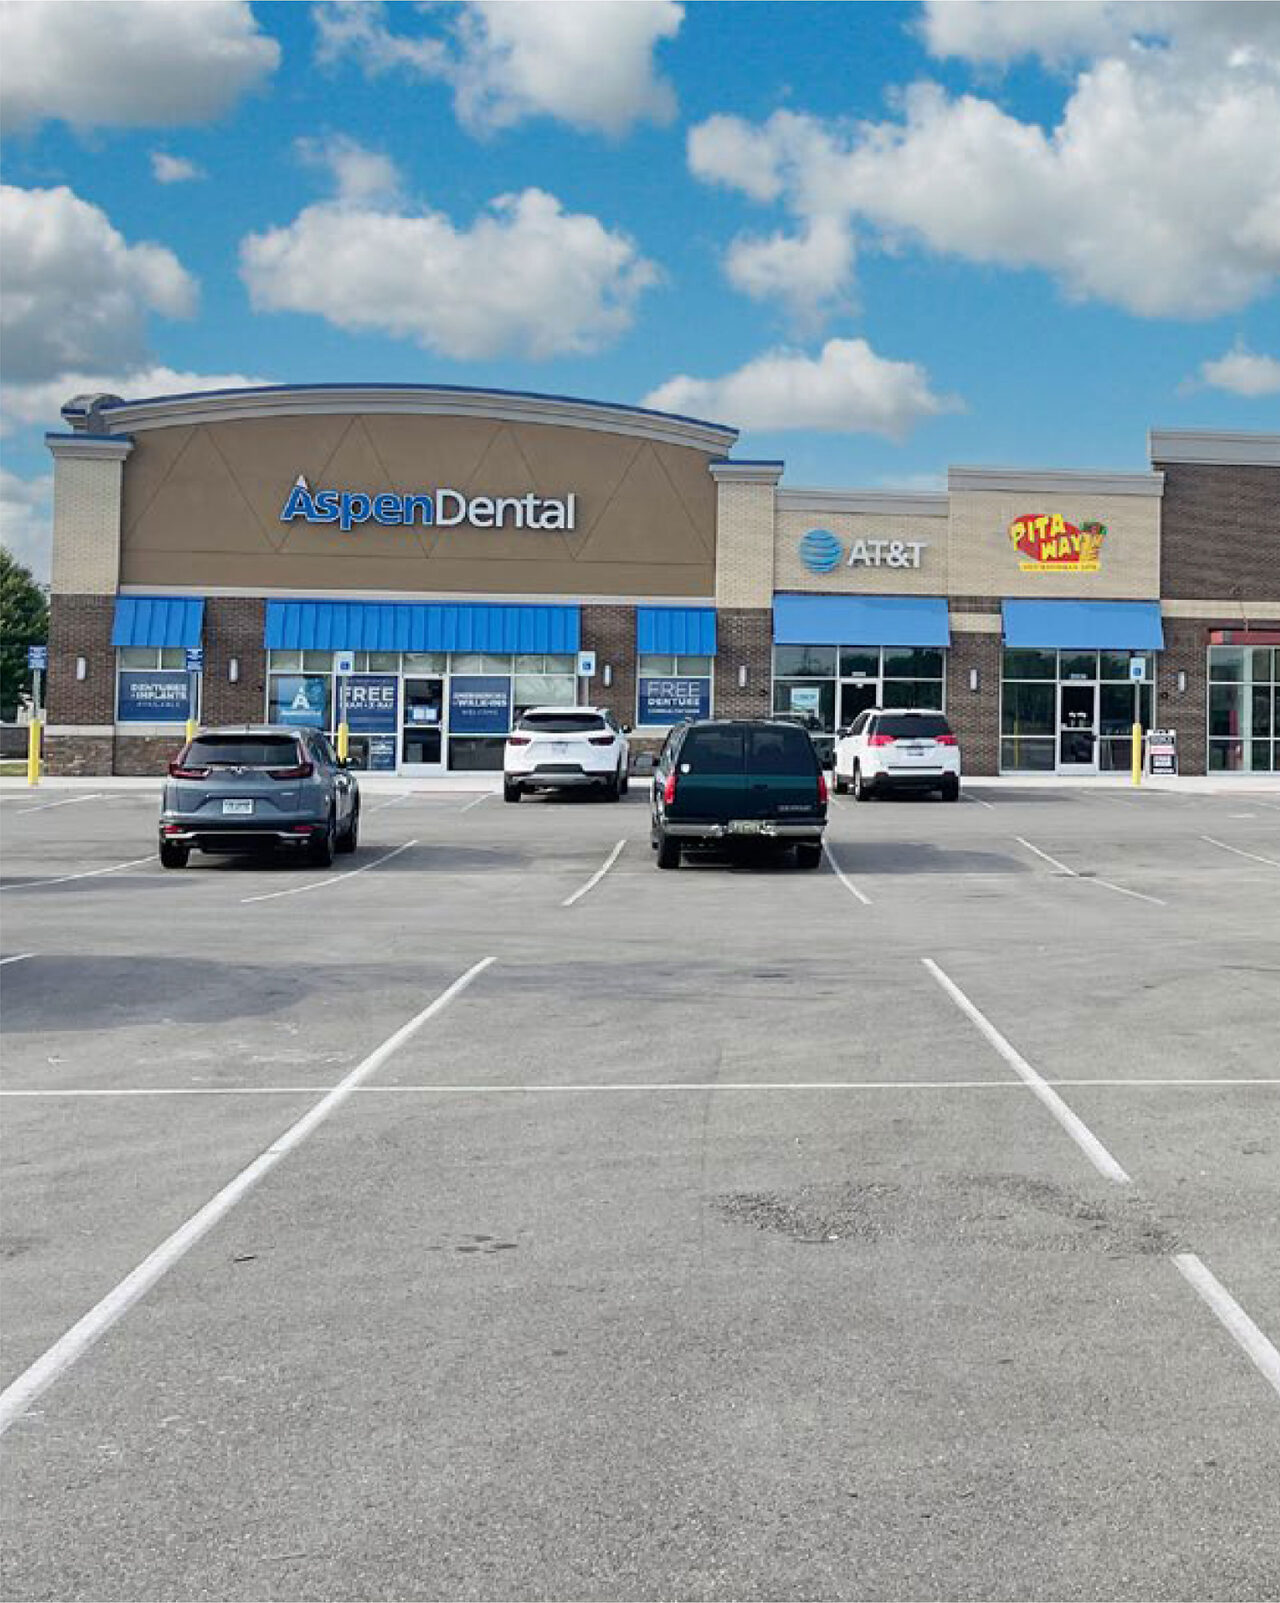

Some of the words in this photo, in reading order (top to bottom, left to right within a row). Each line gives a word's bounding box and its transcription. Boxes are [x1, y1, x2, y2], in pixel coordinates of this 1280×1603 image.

[1012, 513, 1066, 552] PITA
[848, 539, 928, 568] AT&T
[1041, 533, 1081, 561] WAY
[339, 685, 394, 701] FREE
[647, 681, 700, 697] FREE
